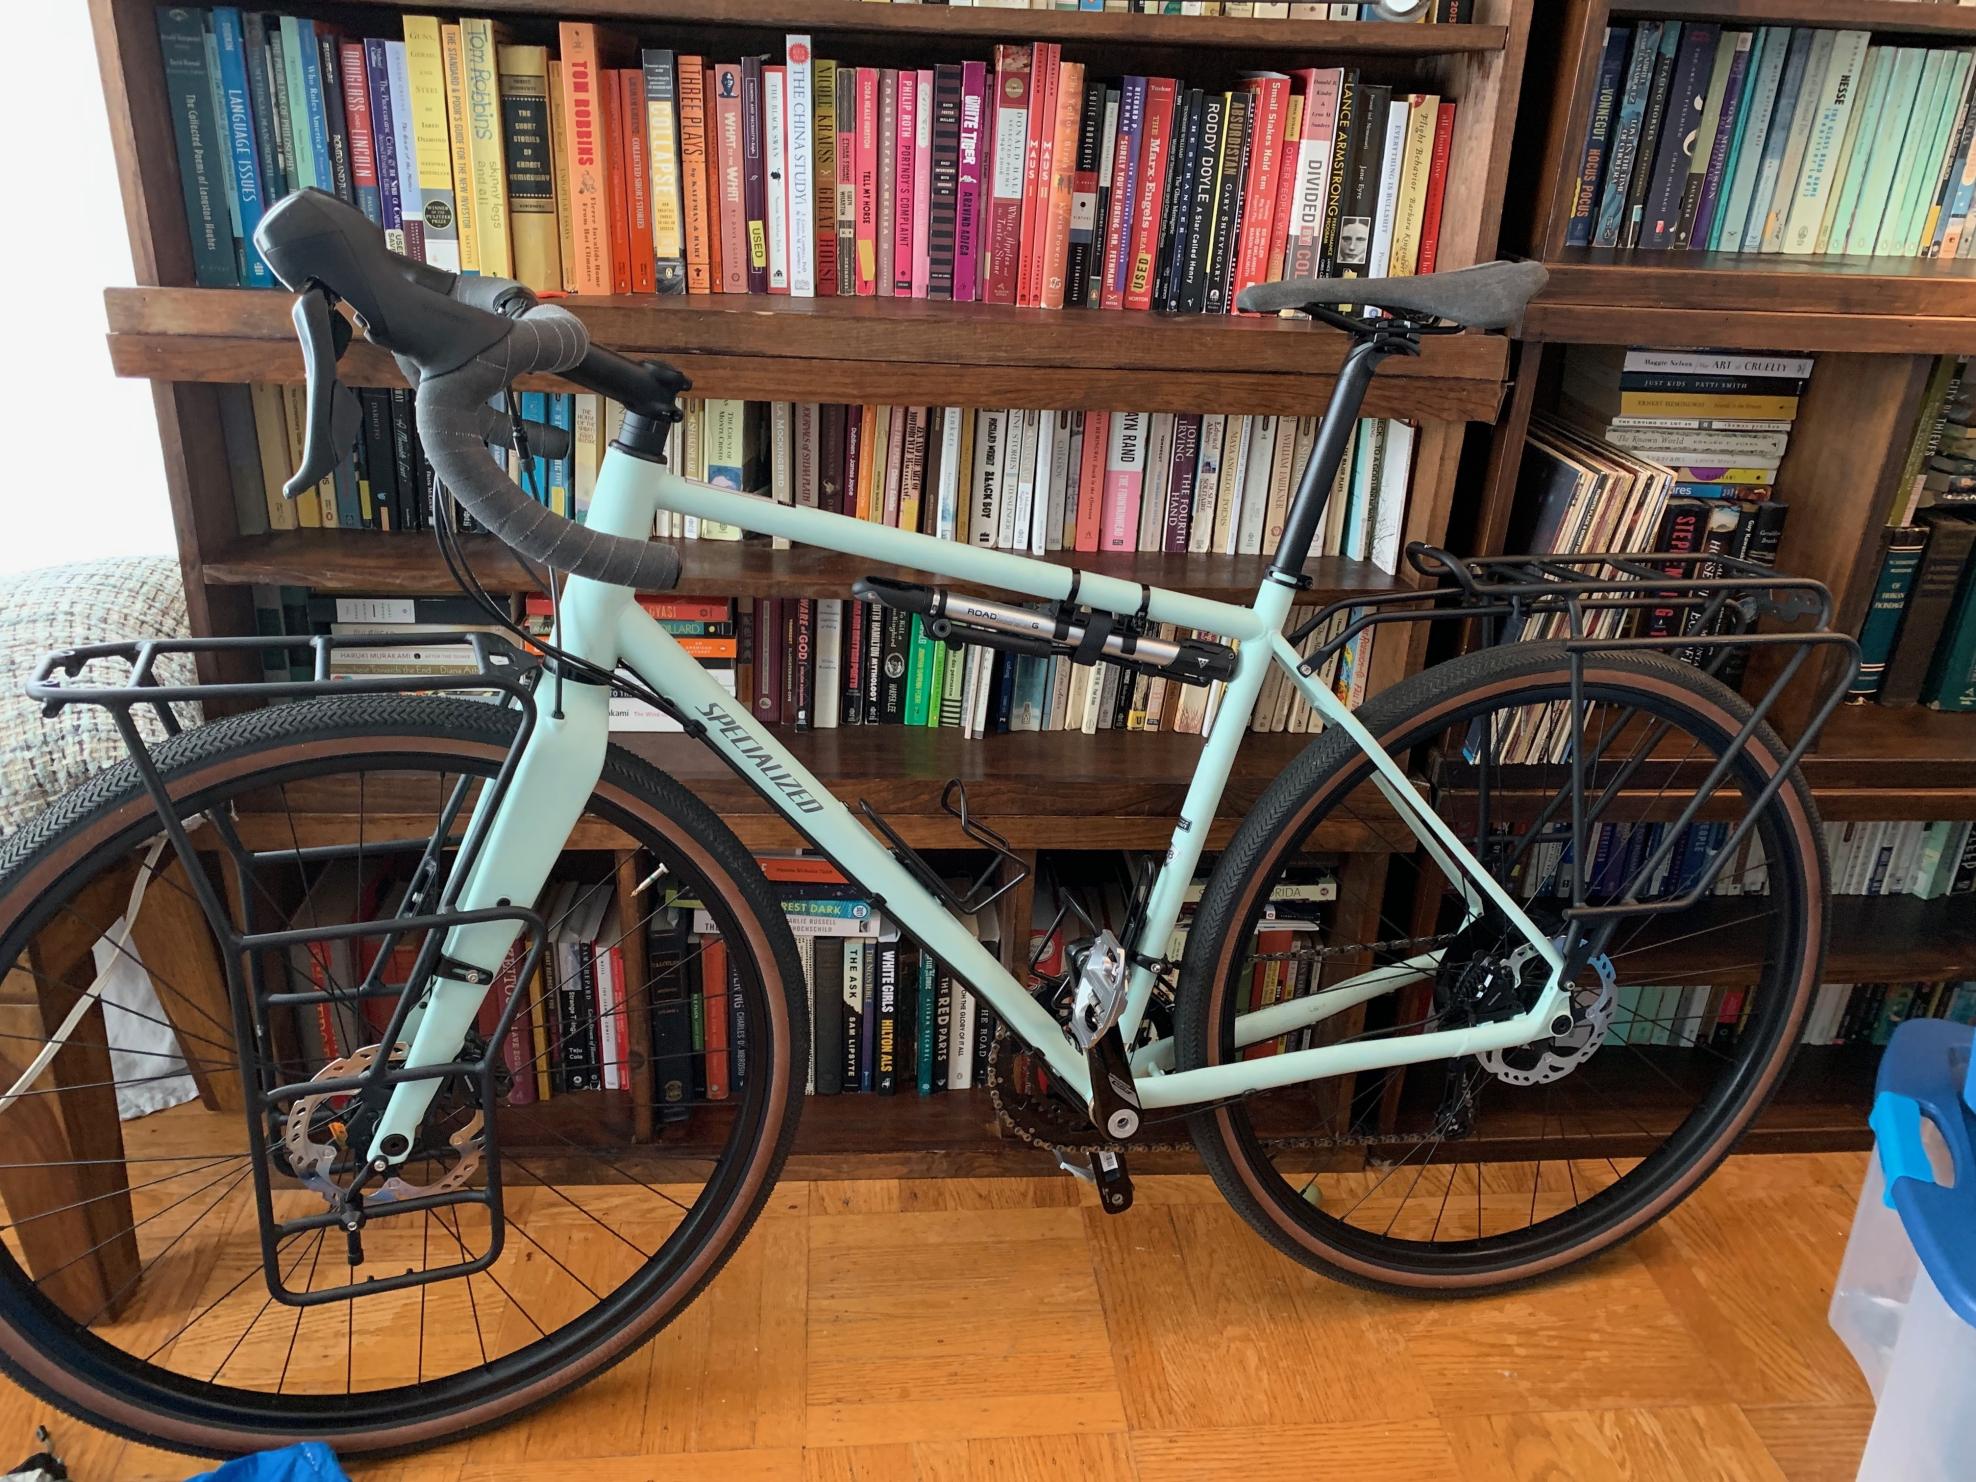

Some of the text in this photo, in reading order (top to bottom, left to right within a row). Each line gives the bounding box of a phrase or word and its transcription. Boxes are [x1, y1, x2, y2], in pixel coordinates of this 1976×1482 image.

[447, 32, 456, 45] THE
[448, 48, 459, 86] STANDARD
[467, 24, 493, 140] Tom Robbins
[1834, 74, 1852, 105] HESSE
[307, 65, 325, 153] Who Rules America?
[343, 51, 371, 177] DOUGLASS LINCOLN
[452, 96, 462, 122] POOR'S
[571, 61, 594, 166] TOM ROBBINS
[681, 70, 704, 156] THREE PLAYS
[901, 80, 913, 138] PHILIP ROTH
[1122, 86, 1133, 132] FEYNMAN
[1269, 82, 1281, 110] Small
[1591, 87, 1614, 141] VONNEGUT
[228, 89, 256, 202] LANGUAGE ISSUES
[453, 124, 464, 145] GUIDE
[456, 147, 466, 160] FOR
[651, 103, 673, 195] COLLAPSE
[792, 68, 807, 200] THE CHINA STUDY
[961, 95, 981, 164] WHITE TIGER
[1011, 112, 1024, 196] DONALD HALL
[1197, 102, 1220, 203] RODDY DOYLE
[1223, 102, 1246, 176] ABSURDISTAN
[1264, 113, 1277, 147] Stakes
[1328, 83, 1354, 217] LANCE ARMSTRONG
[185, 94, 217, 250] The Collected Poems of Langston Hughes
[458, 162, 467, 175] THE
[631, 138, 645, 229] COLLECTED SHORT STORIES
[724, 112, 739, 203] WHAT WHAT
[817, 66, 836, 285] NICOLE KRAUSS GREAT HOUSE
[1028, 139, 1038, 179] MAUS
[1041, 139, 1052, 181] MAUS
[1141, 115, 1160, 229] THE Marx-Engels
[1179, 114, 1198, 234] THE STRANGER
[1262, 149, 1273, 171] Hold
[1356, 165, 1368, 200] Jane Eyre
[1380, 125, 1401, 234] EVERYTHING IS BULLSHIT
[1576, 148, 1601, 217] HOCUS POCUS
[459, 177, 469, 193] NEW
[461, 195, 471, 229] INVESTOR
[488, 160, 503, 229] skinny legs
[862, 171, 871, 225] TELL MY HORSE
[899, 144, 911, 247] PORTNOY'S COMPLAINT
[1276, 146, 1294, 237] OTHER PEOPLE WE
[1302, 160, 1323, 223] DIVIDED
[751, 228, 764, 258] USED
[960, 191, 974, 256] ARAVIND ADIGA
[1189, 234, 1201, 259] Called
[1193, 215, 1204, 231] Star
[1133, 257, 1149, 290] USED
[1186, 260, 1199, 284] Henry
[1695, 381, 1720, 389] PATTI
[802, 406, 811, 445] JOURNALS
[948, 410, 957, 447] tinkers
[1120, 435, 1138, 463] RAND
[1174, 420, 1188, 462] IRVING
[1185, 425, 1197, 457] JOHN
[776, 419, 785, 488] MOCKINGBIRD
[802, 452, 811, 474] SYLVIA
[847, 427, 858, 496] Dubliners James Joyce
[981, 417, 998, 519] RICHARD WRIGHT BLACK BOY
[1219, 431, 1239, 527] MAYA ANGELOU POEMS
[1274, 433, 1292, 510] WILLIAM FAULKNER
[802, 475, 811, 502] PLATH
[1004, 433, 1020, 530] STORIES SALINGER
[1176, 472, 1192, 544] THE FOURTH
[1168, 492, 1181, 527] HAND
[966, 608, 998, 620] ROAD
[798, 634, 809, 660] GOD
[869, 622, 882, 702] HAMILTON MYTHOLOGY
[887, 683, 897, 713] HARPER LEE
[694, 702, 824, 814] SPECIALIZED
[810, 903, 841, 914] DARK
[848, 949, 858, 999] THE ASK
[881, 951, 895, 1013] WHITE GIRLS
[881, 1019, 893, 1072] HILTON ALS
[937, 977, 950, 1061] THE RED PARTS
[958, 1032, 966, 1040] OF
[959, 1011, 967, 1031] GLORY
[979, 1029, 988, 1058] ROAD
[847, 1017, 856, 1077] SAM LIPSYTE
